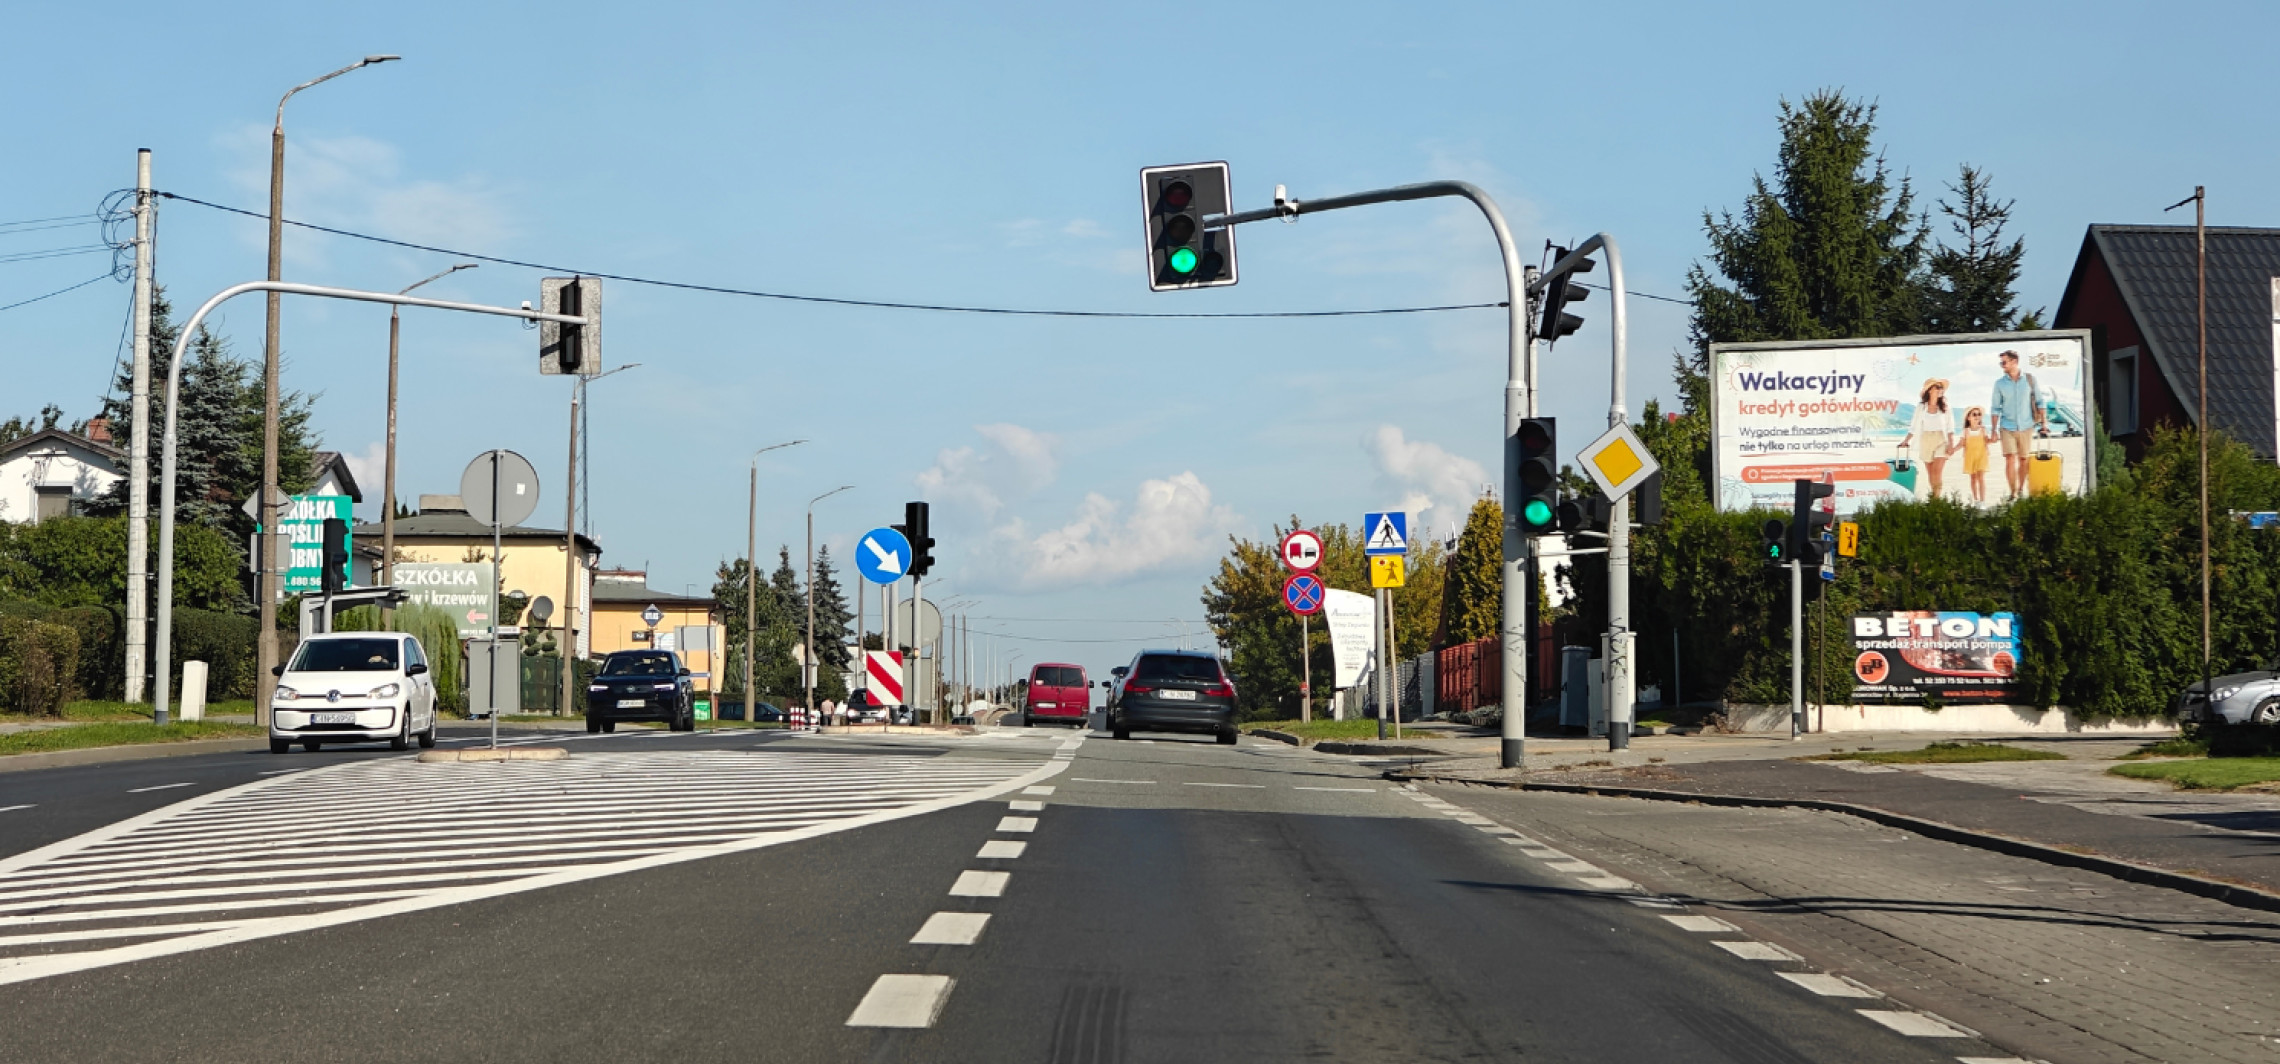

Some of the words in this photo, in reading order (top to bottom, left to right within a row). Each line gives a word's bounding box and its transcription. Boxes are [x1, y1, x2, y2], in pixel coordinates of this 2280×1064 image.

[1738, 369, 1866, 395] Wakacyjny
[1739, 399, 1796, 418] kredyt
[1798, 397, 1898, 417] gotówkowy
[1739, 426, 1789, 438] Wygodne
[1739, 441, 1756, 452] nie
[1757, 440, 1785, 453] tylko
[1786, 441, 1801, 450] na
[1802, 439, 1829, 451] urlop
[284, 496, 337, 520] KÓŁKA
[394, 566, 478, 586] SZKÓŁKA
[431, 589, 489, 605] krzewów
[1854, 616, 2012, 638] BETON
[1970, 639, 2013, 651] pompa
